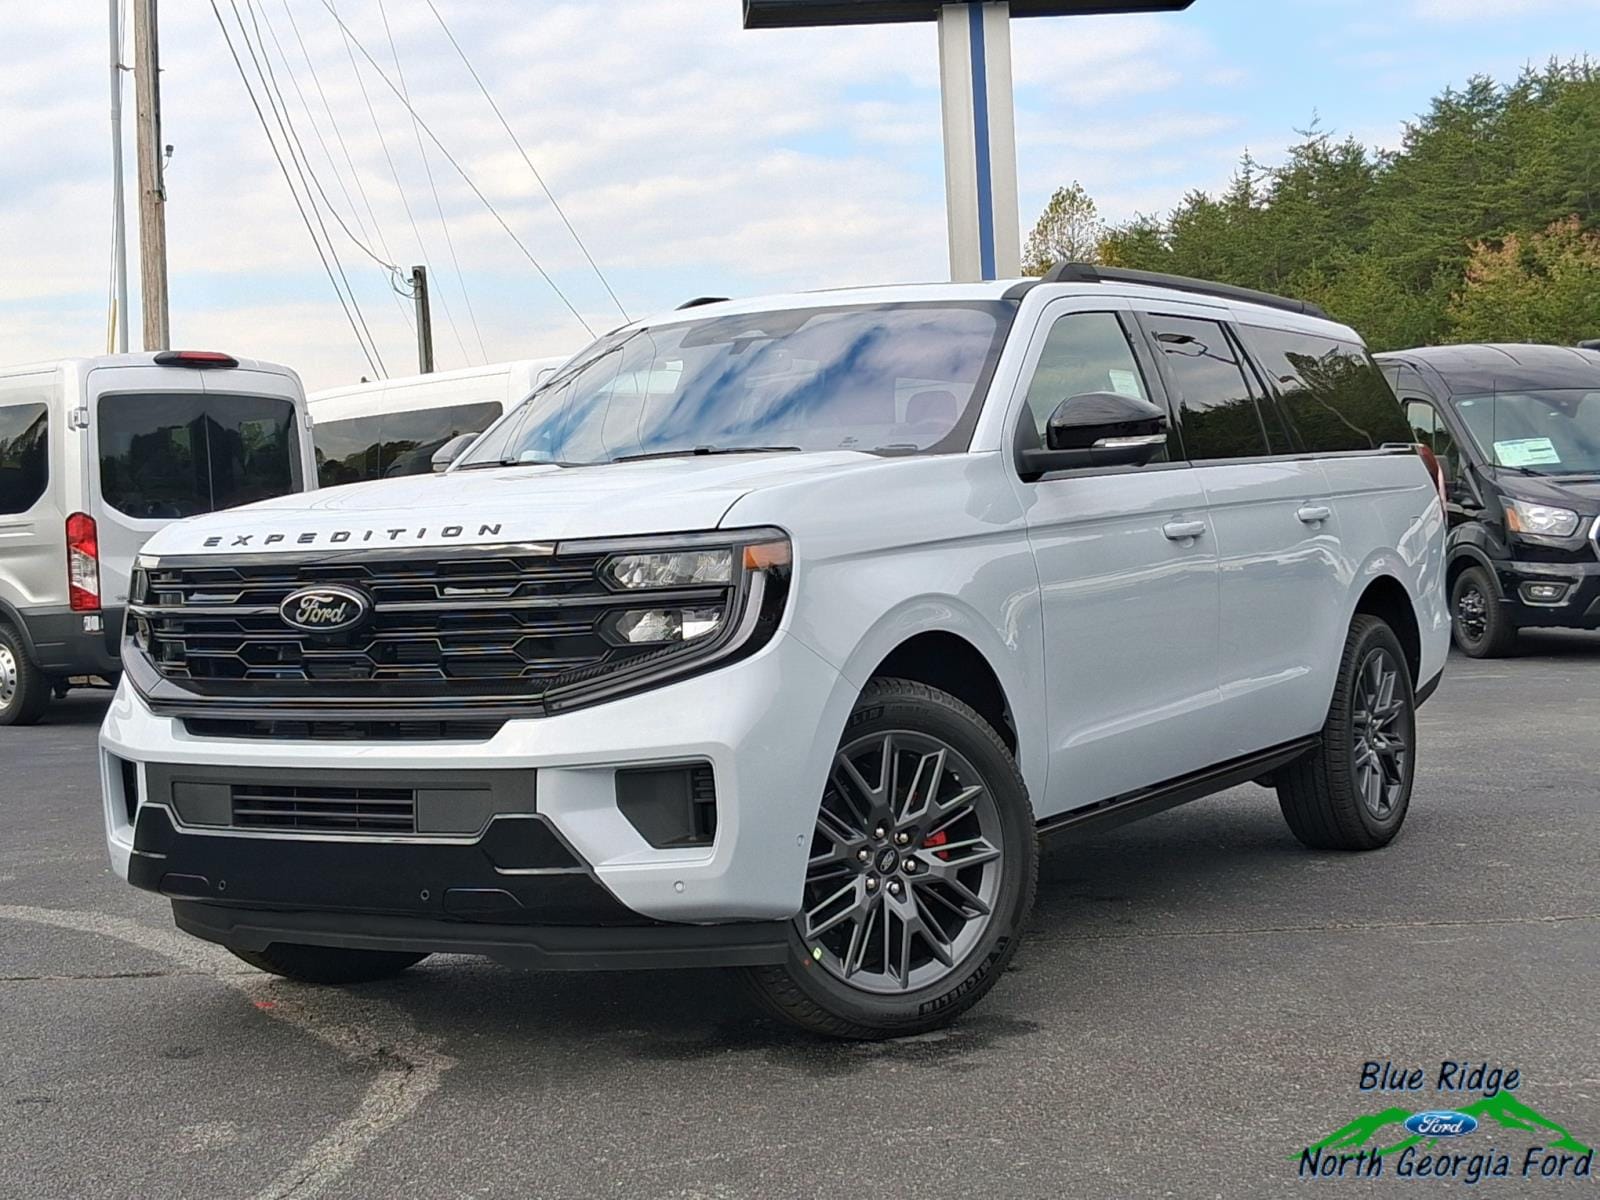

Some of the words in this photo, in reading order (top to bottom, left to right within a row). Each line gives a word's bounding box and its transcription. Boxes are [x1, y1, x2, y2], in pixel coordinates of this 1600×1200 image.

[203, 524, 502, 547] EXPEDITION
[296, 594, 346, 622] Ford
[922, 956, 993, 1012] MICHELIN
